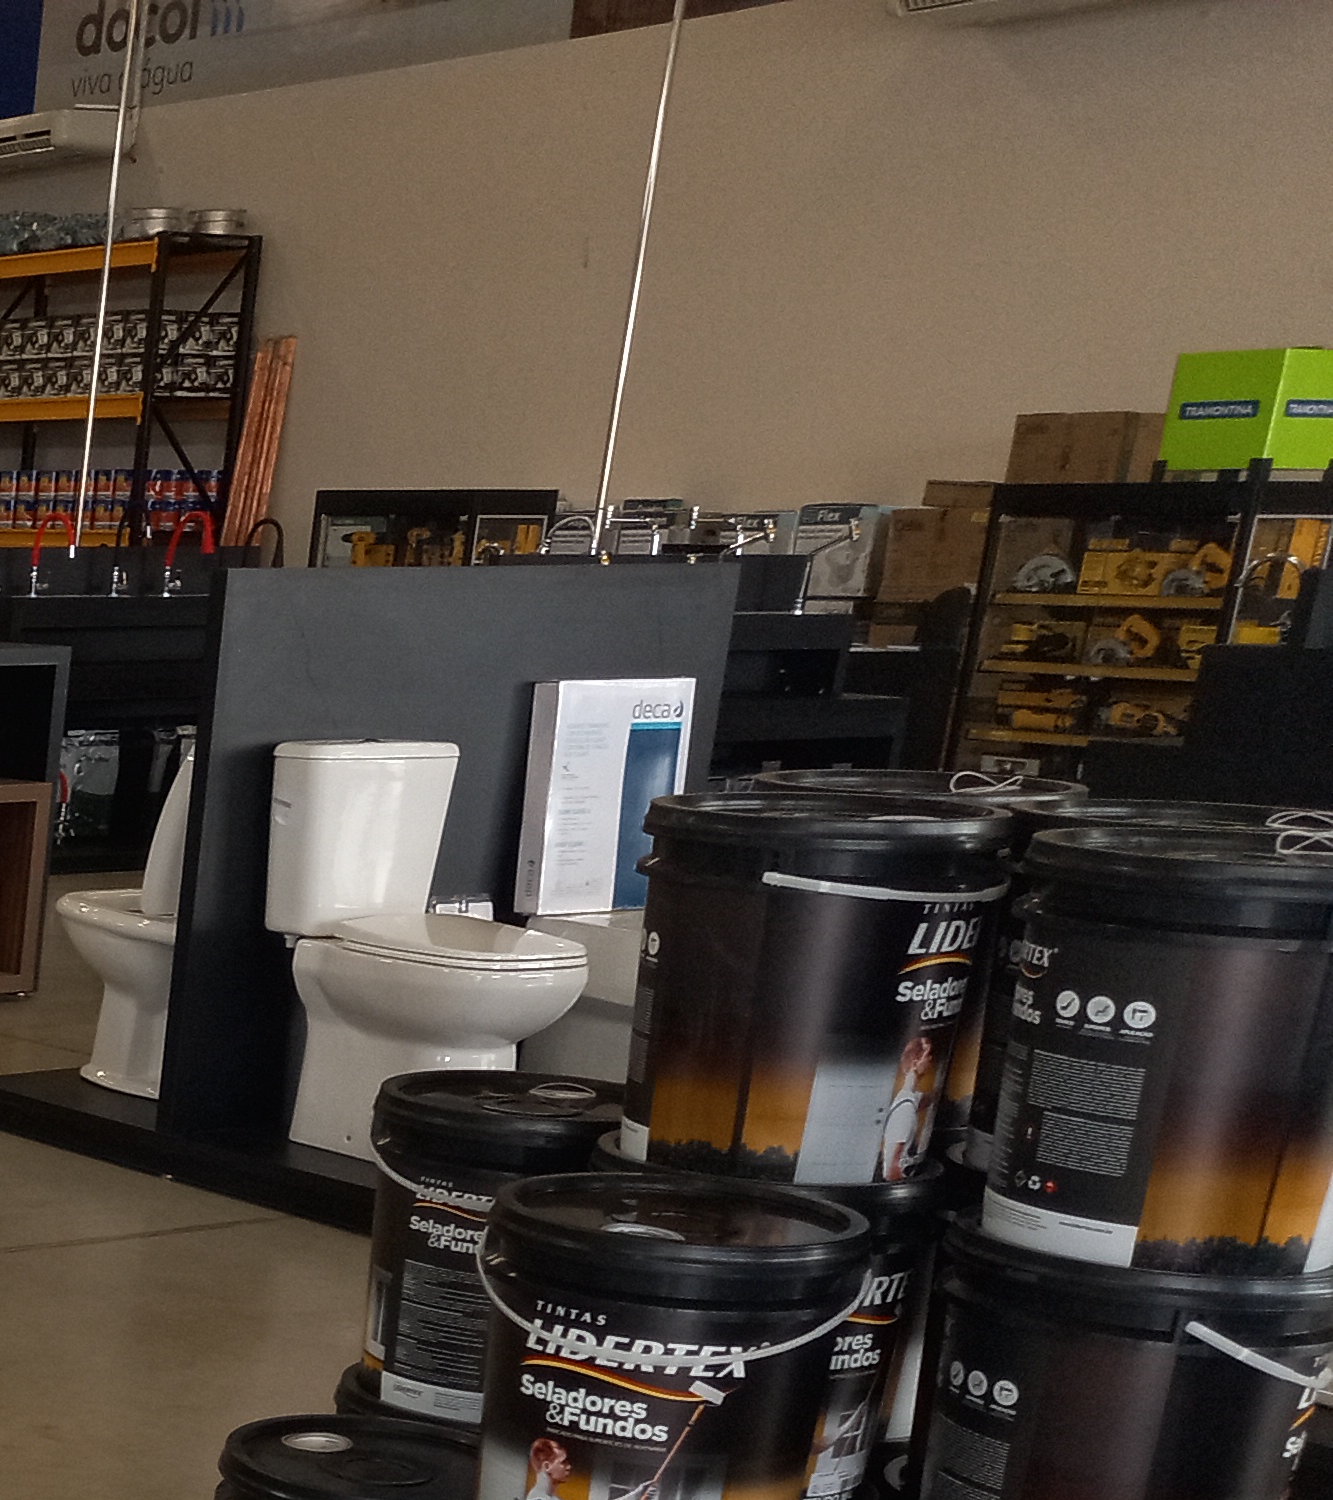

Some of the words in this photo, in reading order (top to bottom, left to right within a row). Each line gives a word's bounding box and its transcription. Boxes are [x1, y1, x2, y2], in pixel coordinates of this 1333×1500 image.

[633, 701, 671, 719] deca
[536, 1300, 607, 1326] TINTAS
[526, 1318, 757, 1379] LIDERTEX
[520, 1373, 649, 1420] Seladores
[545, 1403, 669, 1443] &Fundos
